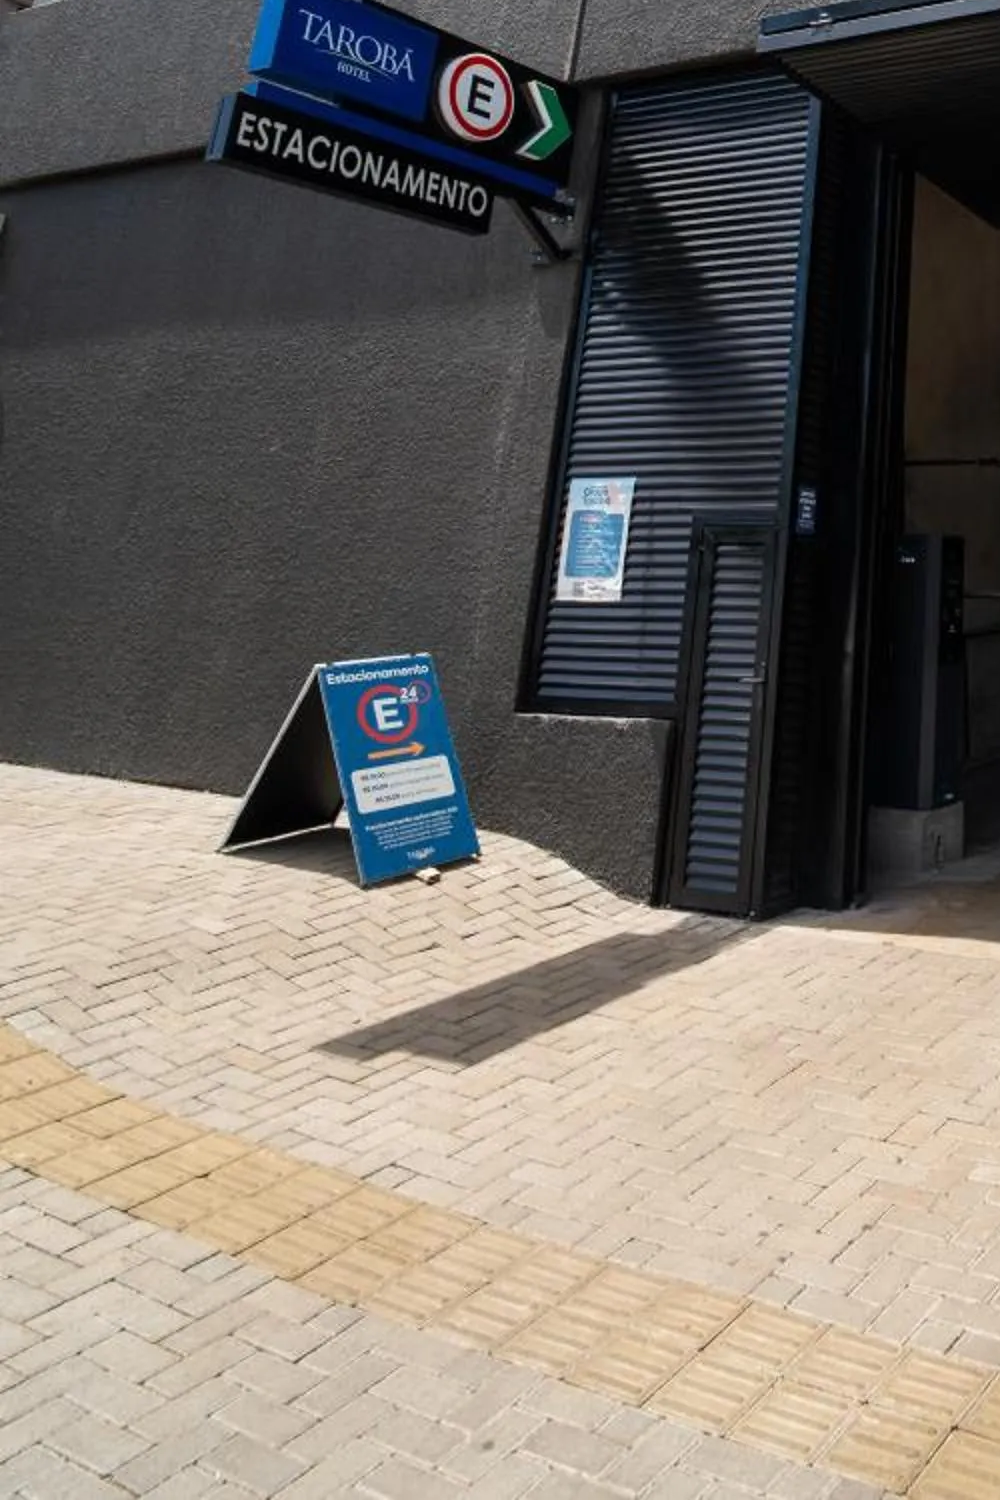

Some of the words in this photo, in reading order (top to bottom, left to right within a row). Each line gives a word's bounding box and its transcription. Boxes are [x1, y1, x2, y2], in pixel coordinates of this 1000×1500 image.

[298, 8, 416, 82] TAROBÁ
[336, 60, 372, 83] HOTEL
[467, 73, 495, 120] E
[235, 111, 488, 217] ESTACIONAMENTO
[326, 664, 429, 685] Estacionamento
[372, 697, 404, 732] E
